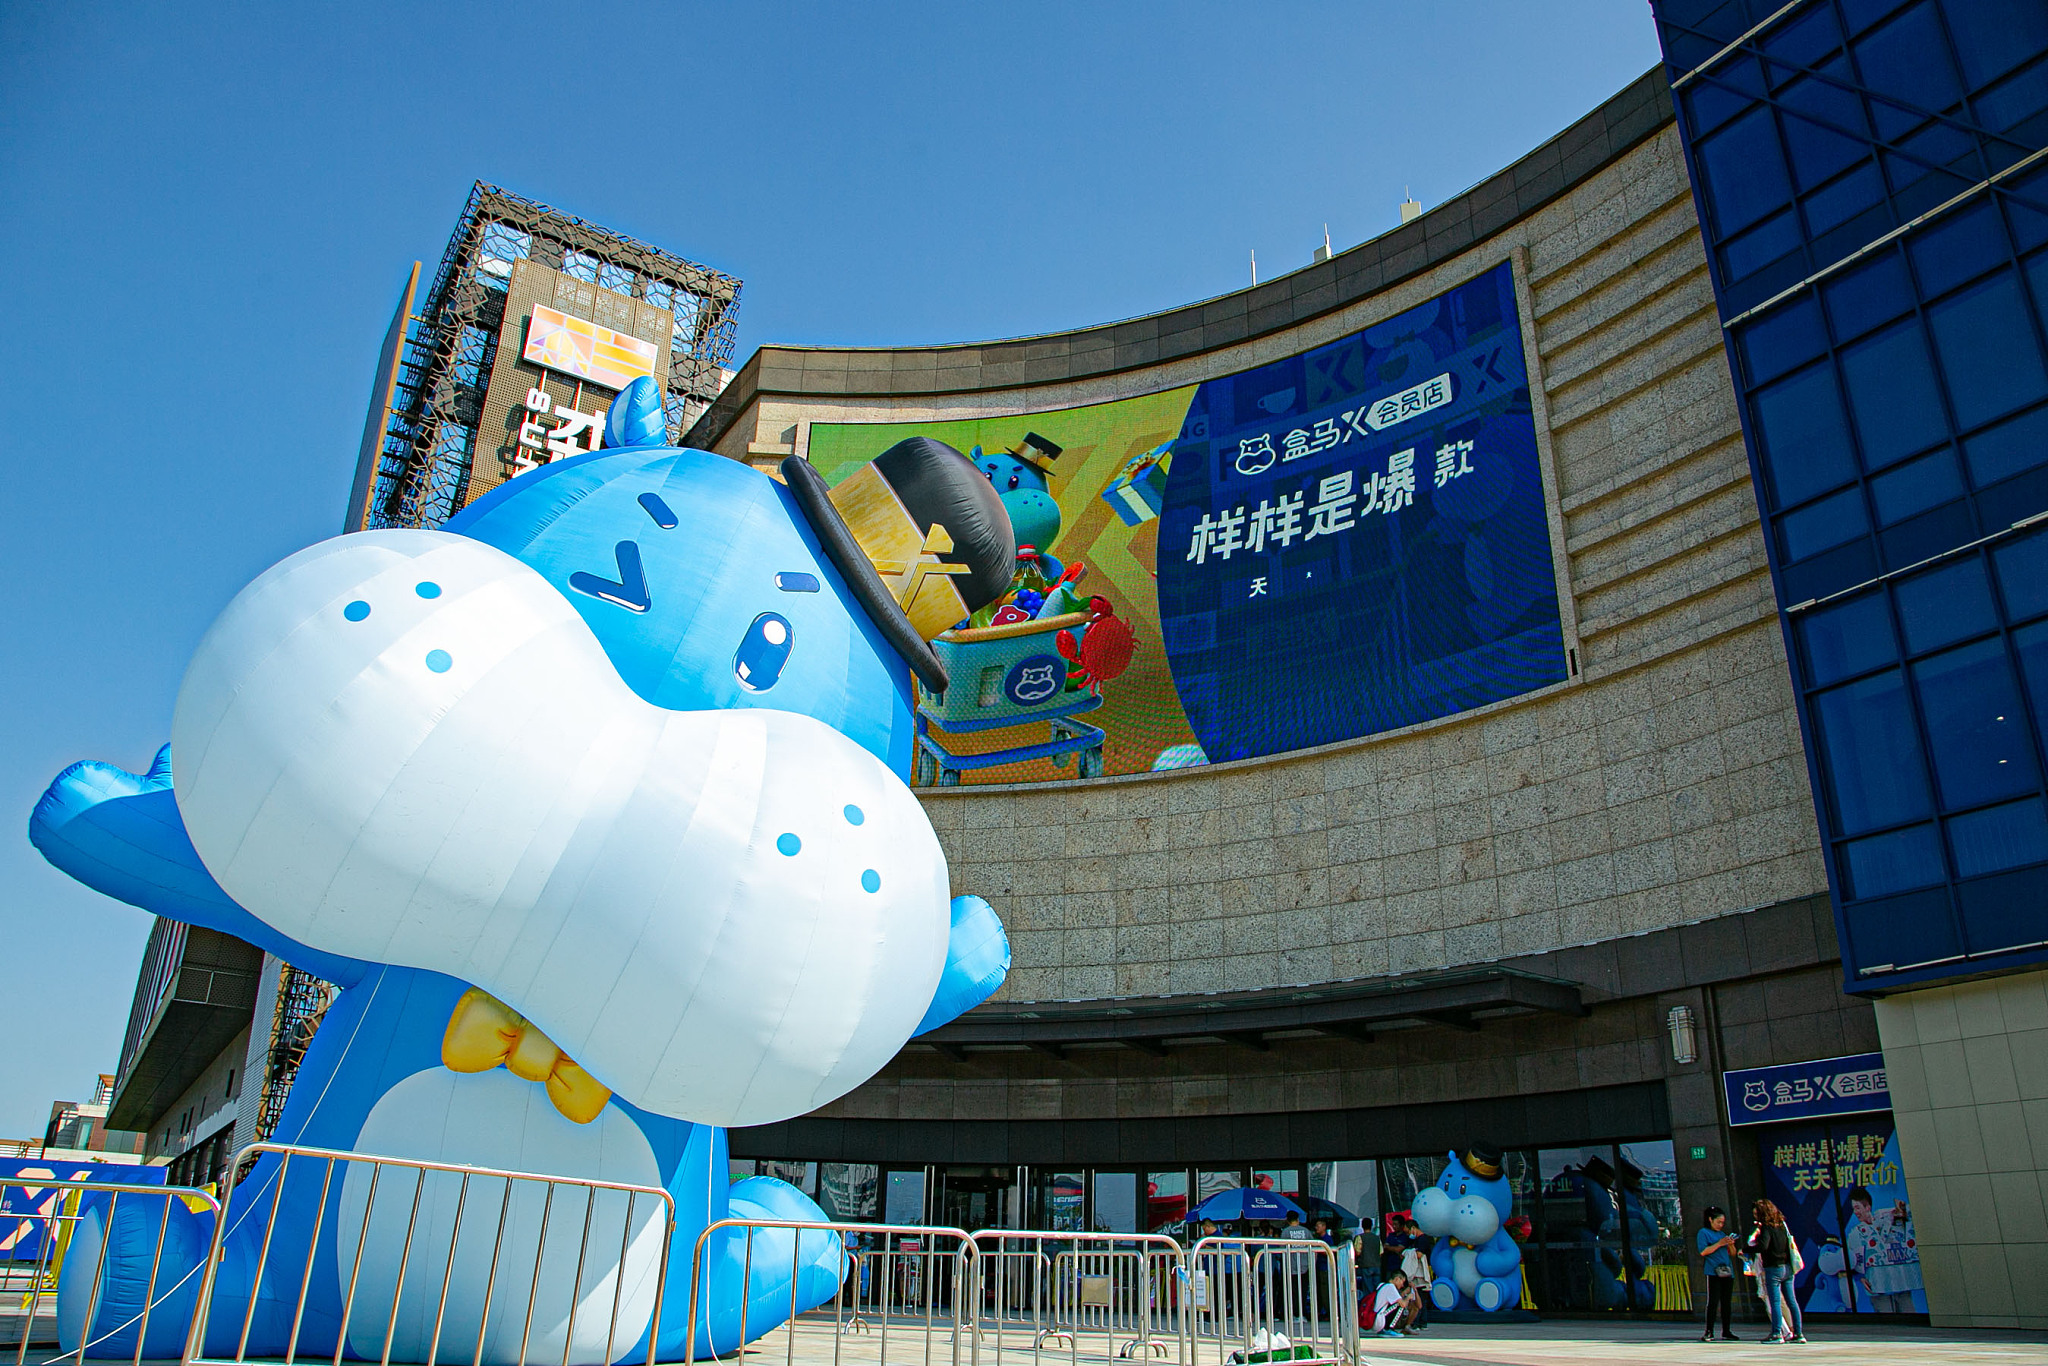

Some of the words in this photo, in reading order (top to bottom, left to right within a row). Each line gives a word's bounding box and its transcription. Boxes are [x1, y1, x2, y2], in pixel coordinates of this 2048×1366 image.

[1774, 1134, 1885, 1168] 样样是爆款
